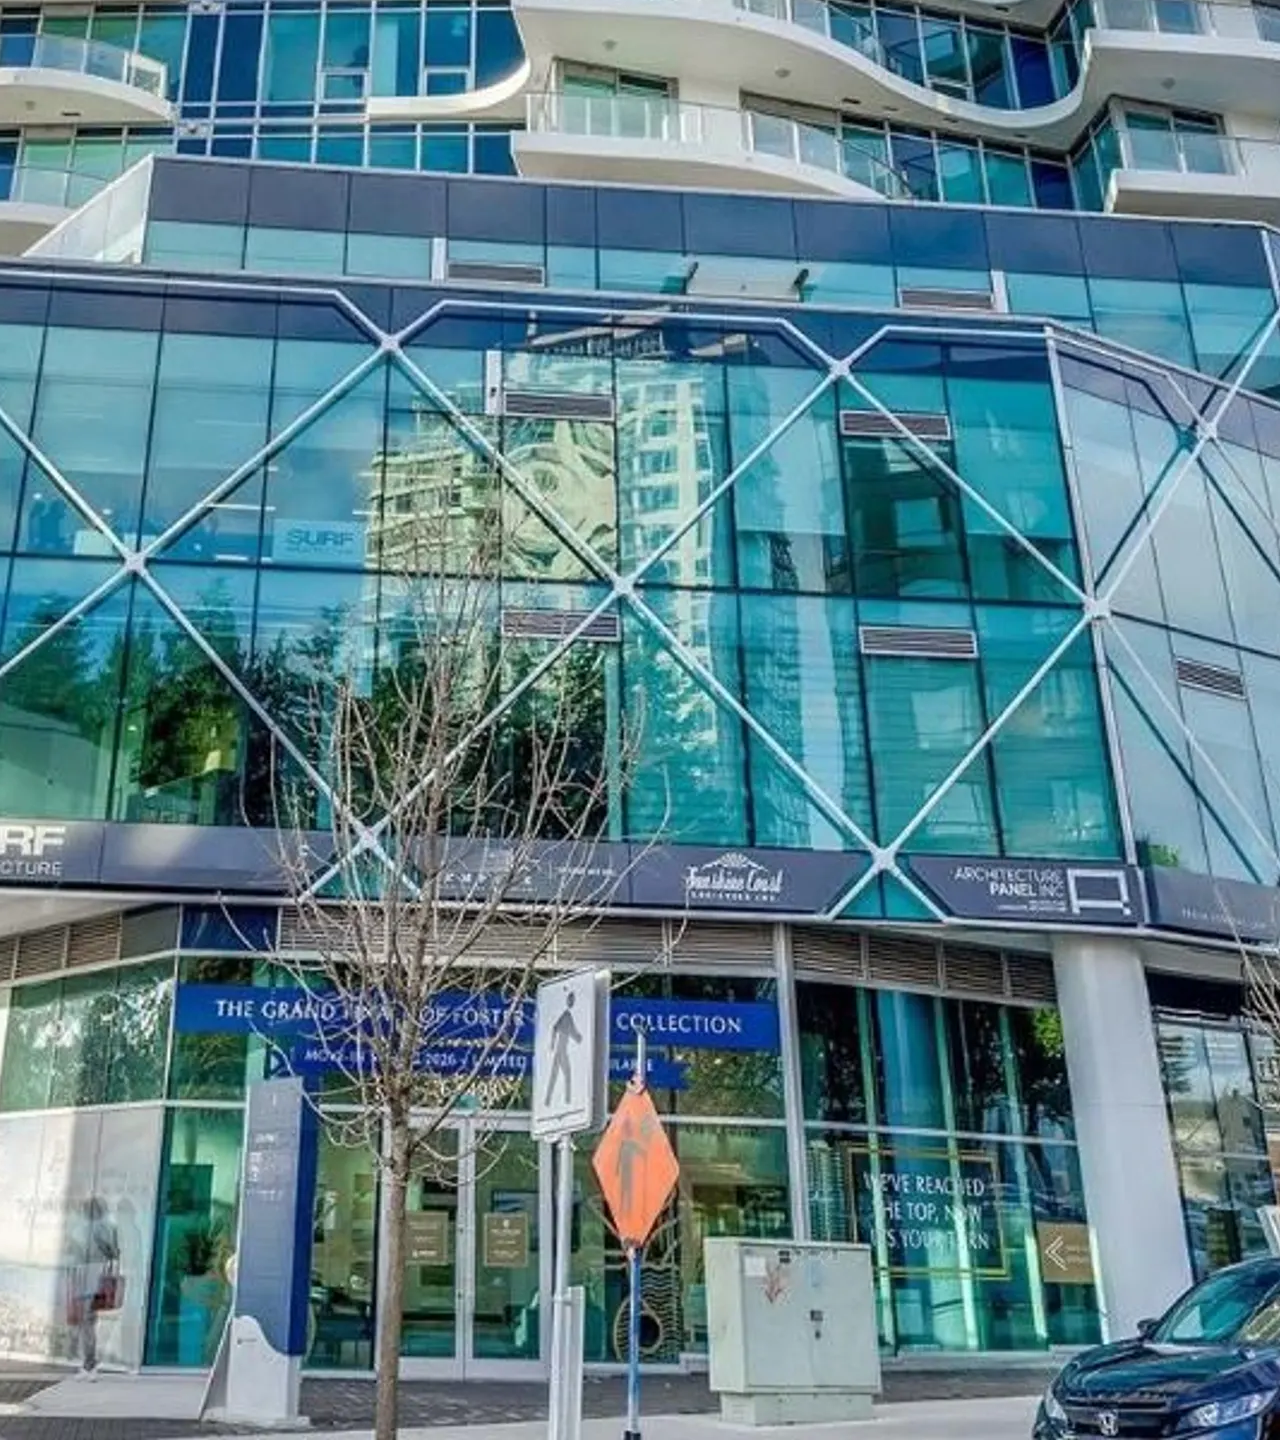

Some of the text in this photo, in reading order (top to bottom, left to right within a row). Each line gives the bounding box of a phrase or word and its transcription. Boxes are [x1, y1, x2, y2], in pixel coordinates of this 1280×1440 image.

[287, 528, 355, 546] SURF
[952, 866, 1064, 884] ARCHITECTURE
[990, 881, 1037, 897] PANEL
[215, 1000, 253, 1018] THE
[261, 1000, 336, 1021] GRAND
[616, 1012, 742, 1034] COLLECTION
